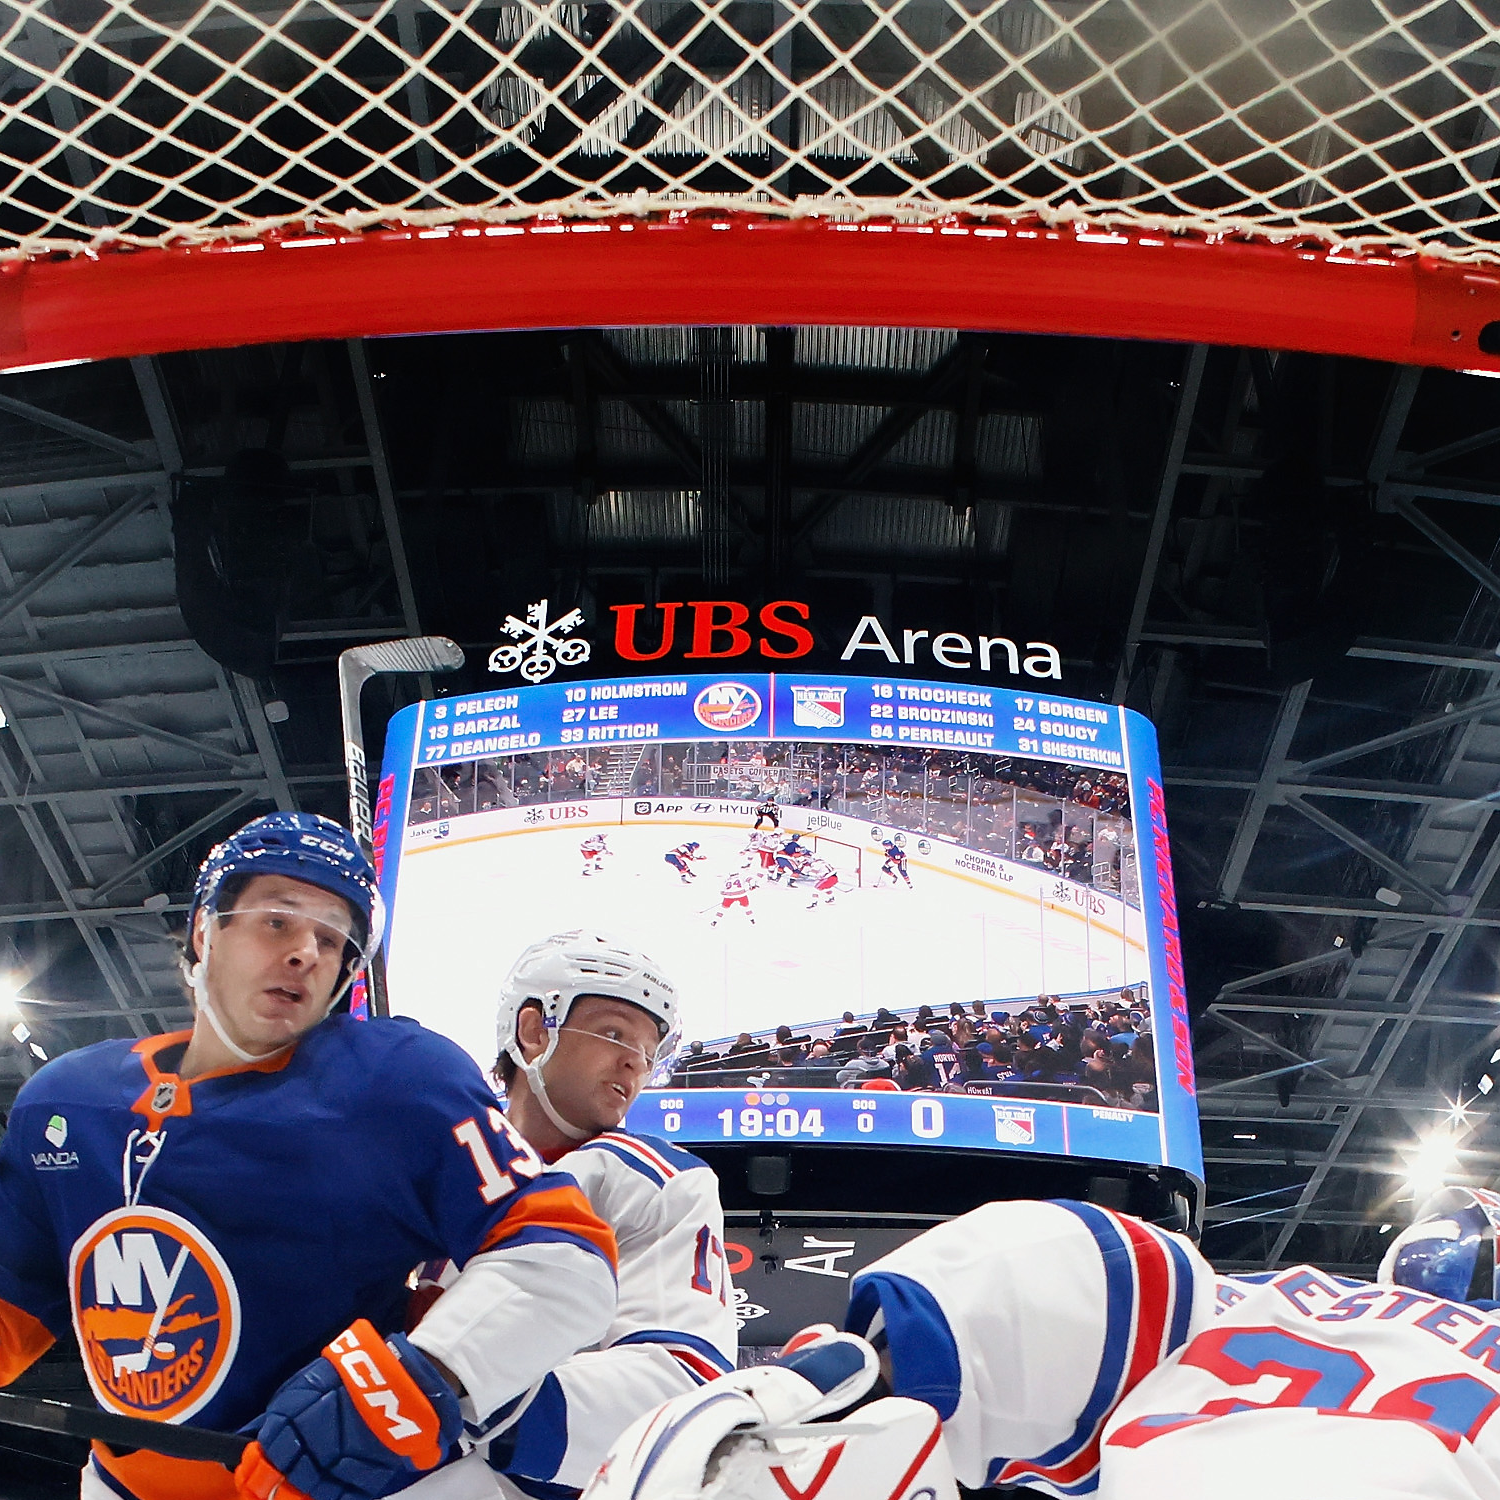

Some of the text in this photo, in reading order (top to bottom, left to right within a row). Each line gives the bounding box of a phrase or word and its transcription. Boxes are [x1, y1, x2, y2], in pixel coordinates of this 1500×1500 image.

[609, 599, 1063, 681] UBS Arena
[565, 682, 688, 703] 10 HOLMSTROM
[897, 686, 992, 708] TROCHECK
[435, 696, 519, 720] 3 PELECH
[562, 705, 619, 723] 27 LEE
[870, 704, 995, 728] 22 BRODZINSKI
[1014, 697, 1109, 724] 17 BORGEN
[428, 715, 521, 741] 13 BARZAL
[561, 723, 659, 744] 33 RITTICH
[898, 727, 995, 749] PERREAULT
[1013, 718, 1098, 742] 24 SOUCY
[425, 732, 541, 761] 77 DEANGELO
[1018, 737, 1123, 766] 31 SHESTERKIN
[549, 804, 589, 821] UBS
[807, 814, 843, 832] jetBlue
[300, 834, 355, 861] CCM
[964, 853, 997, 871] CHOPRA
[1000, 870, 1014, 883] LLP
[1073, 888, 1107, 917] UBS
[1171, 1013, 1196, 1097] SON
[660, 1099, 684, 1110] SOG
[852, 1099, 877, 1111] SOG
[1092, 1108, 1135, 1124] PENALTY
[664, 1112, 681, 1133] 0
[717, 1107, 826, 1139] 19:04
[857, 1112, 875, 1134] 0
[911, 1099, 944, 1139] 0
[30, 1150, 80, 1169] VANDA
[455, 1104, 544, 1205] 13
[327, 1329, 422, 1441] CCM
